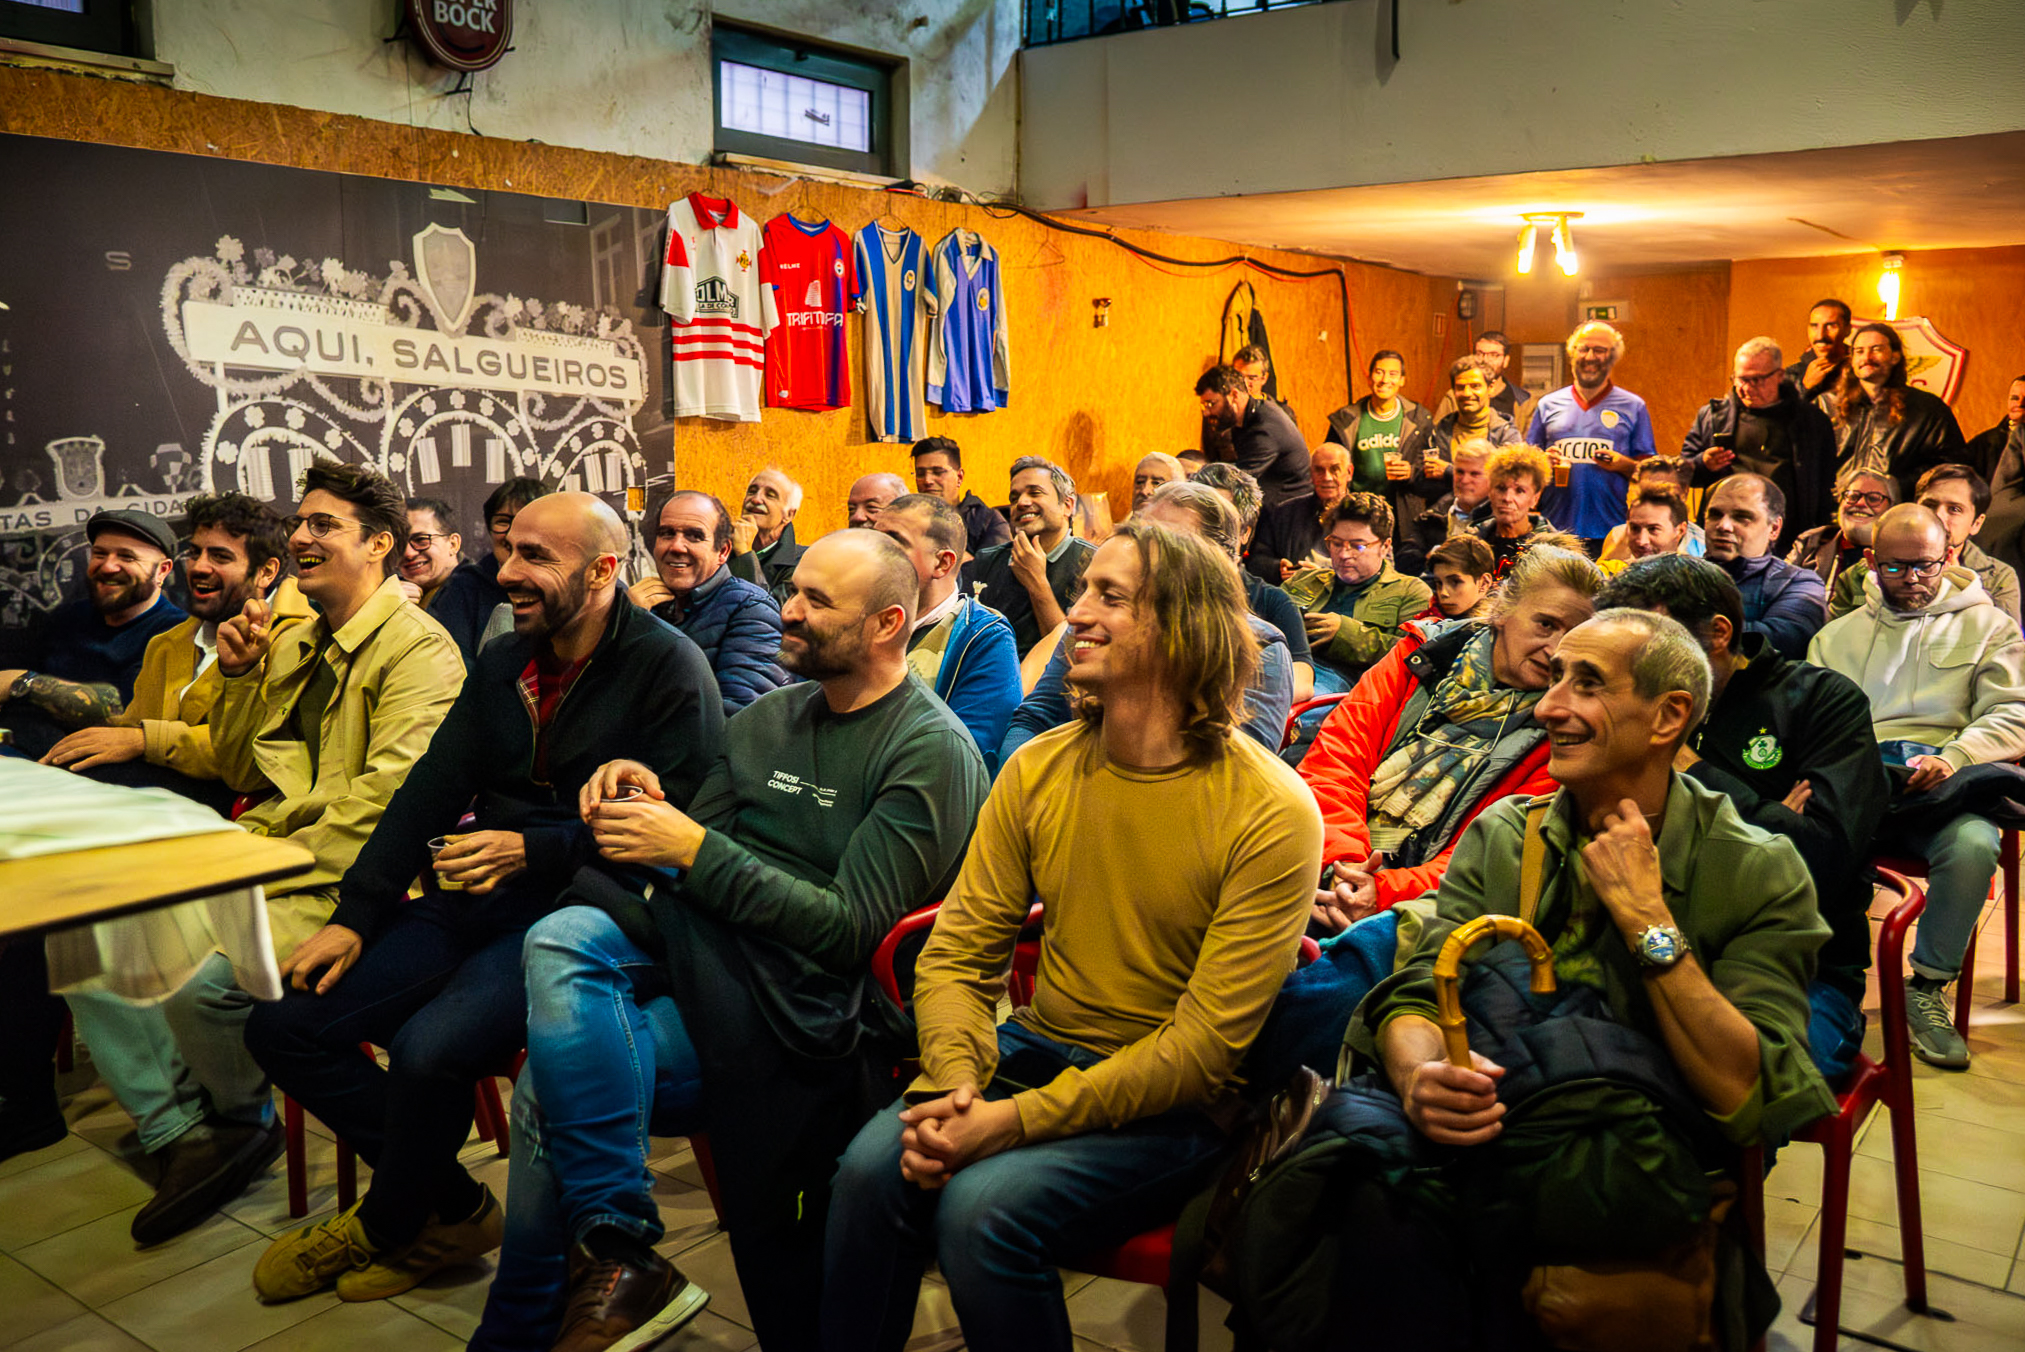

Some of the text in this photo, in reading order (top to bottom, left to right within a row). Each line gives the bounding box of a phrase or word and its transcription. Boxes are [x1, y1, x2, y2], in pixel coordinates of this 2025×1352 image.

[434, 1, 496, 34] BOCK
[230, 320, 627, 389] AQUI, SALGUEIROS
[767, 779, 803, 795] CONCEPT
[773, 770, 800, 784] TIFFOSI
